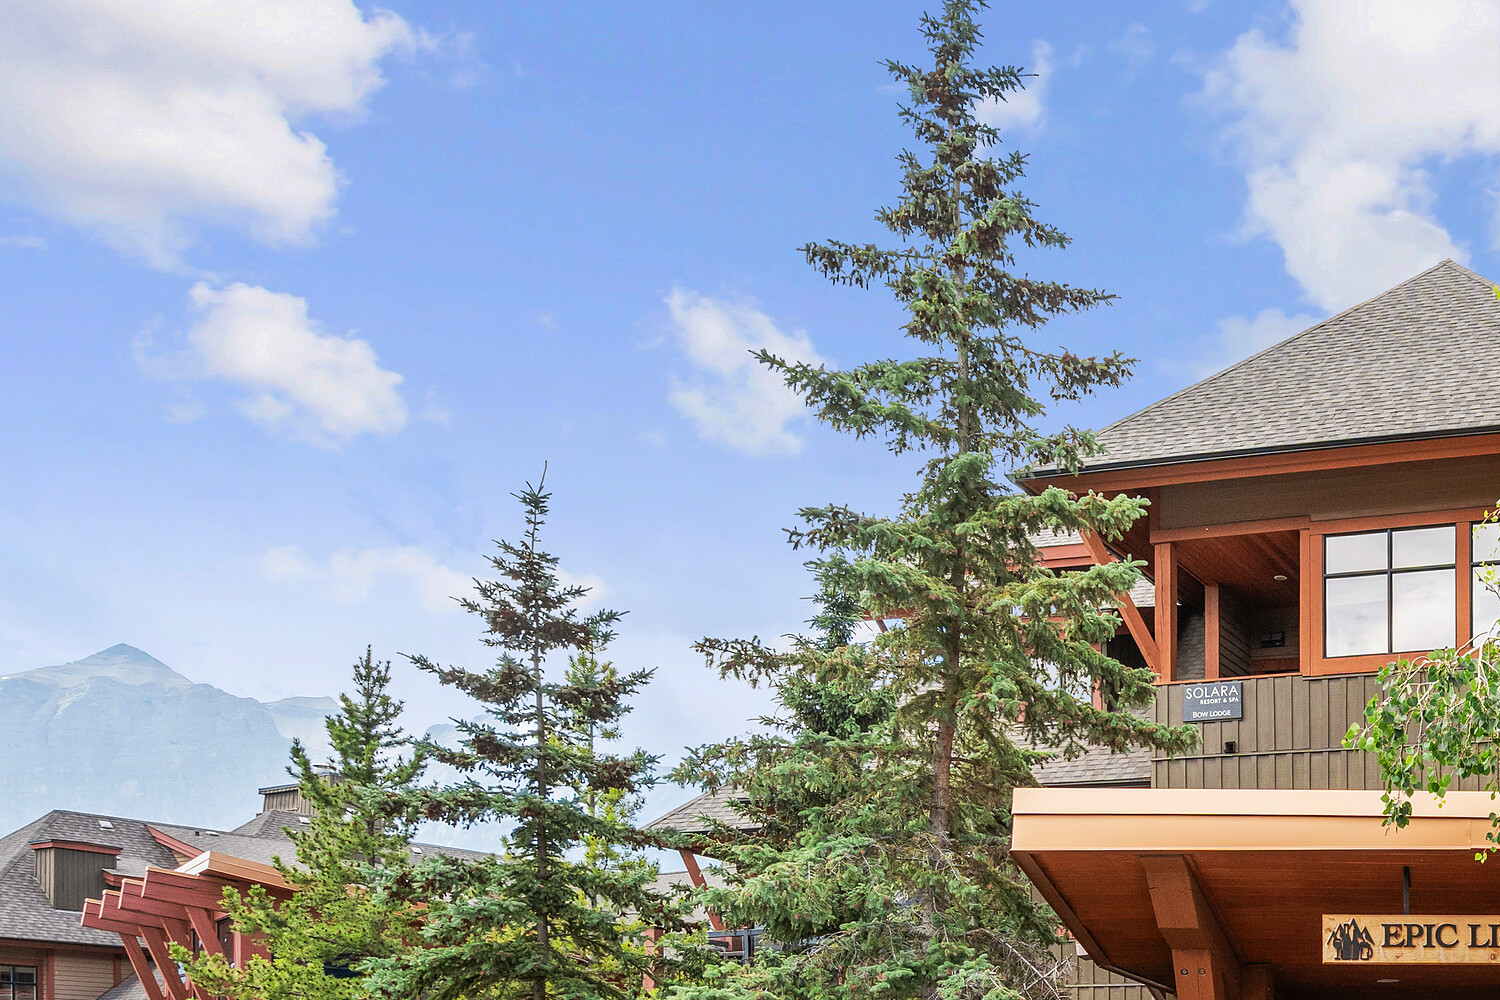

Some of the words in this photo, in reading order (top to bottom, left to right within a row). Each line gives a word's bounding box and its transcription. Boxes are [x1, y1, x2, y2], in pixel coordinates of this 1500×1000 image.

[1186, 685, 1239, 699] SOLARA
[1209, 709, 1232, 717] LODGE
[1380, 922, 1460, 948] EPIC
